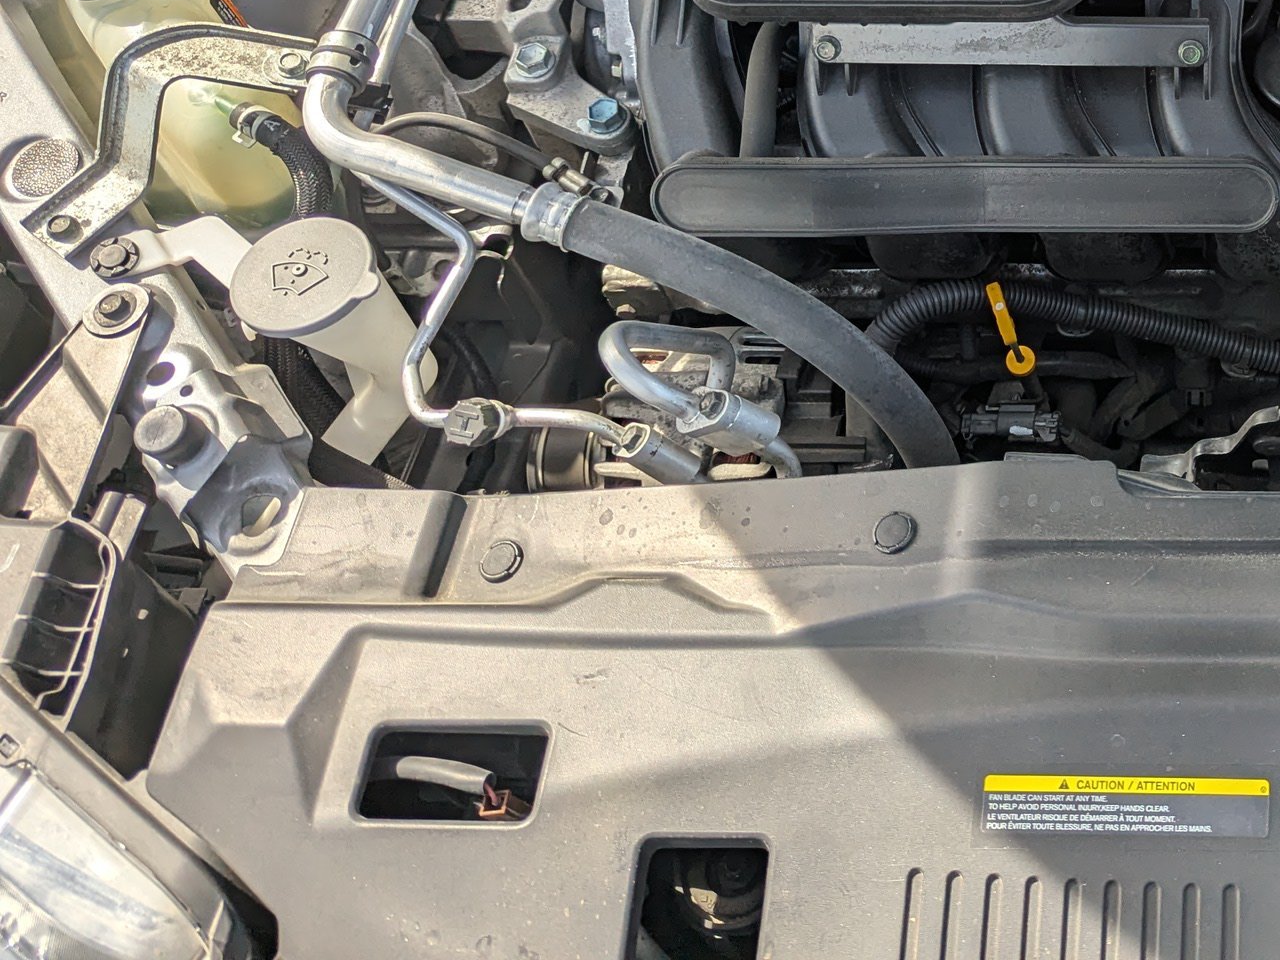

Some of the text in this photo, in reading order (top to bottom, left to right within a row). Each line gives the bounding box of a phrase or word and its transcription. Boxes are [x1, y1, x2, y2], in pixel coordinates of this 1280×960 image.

[1076, 780, 1196, 791] CAUTION / ATTENTION
[1080, 813, 1118, 821] DÉMARRER
[1119, 813, 1124, 821] À
[1008, 821, 1031, 829] ÉVITER
[1055, 823, 1093, 831] BLESSURE,
[1189, 825, 1212, 833] MAINS.
